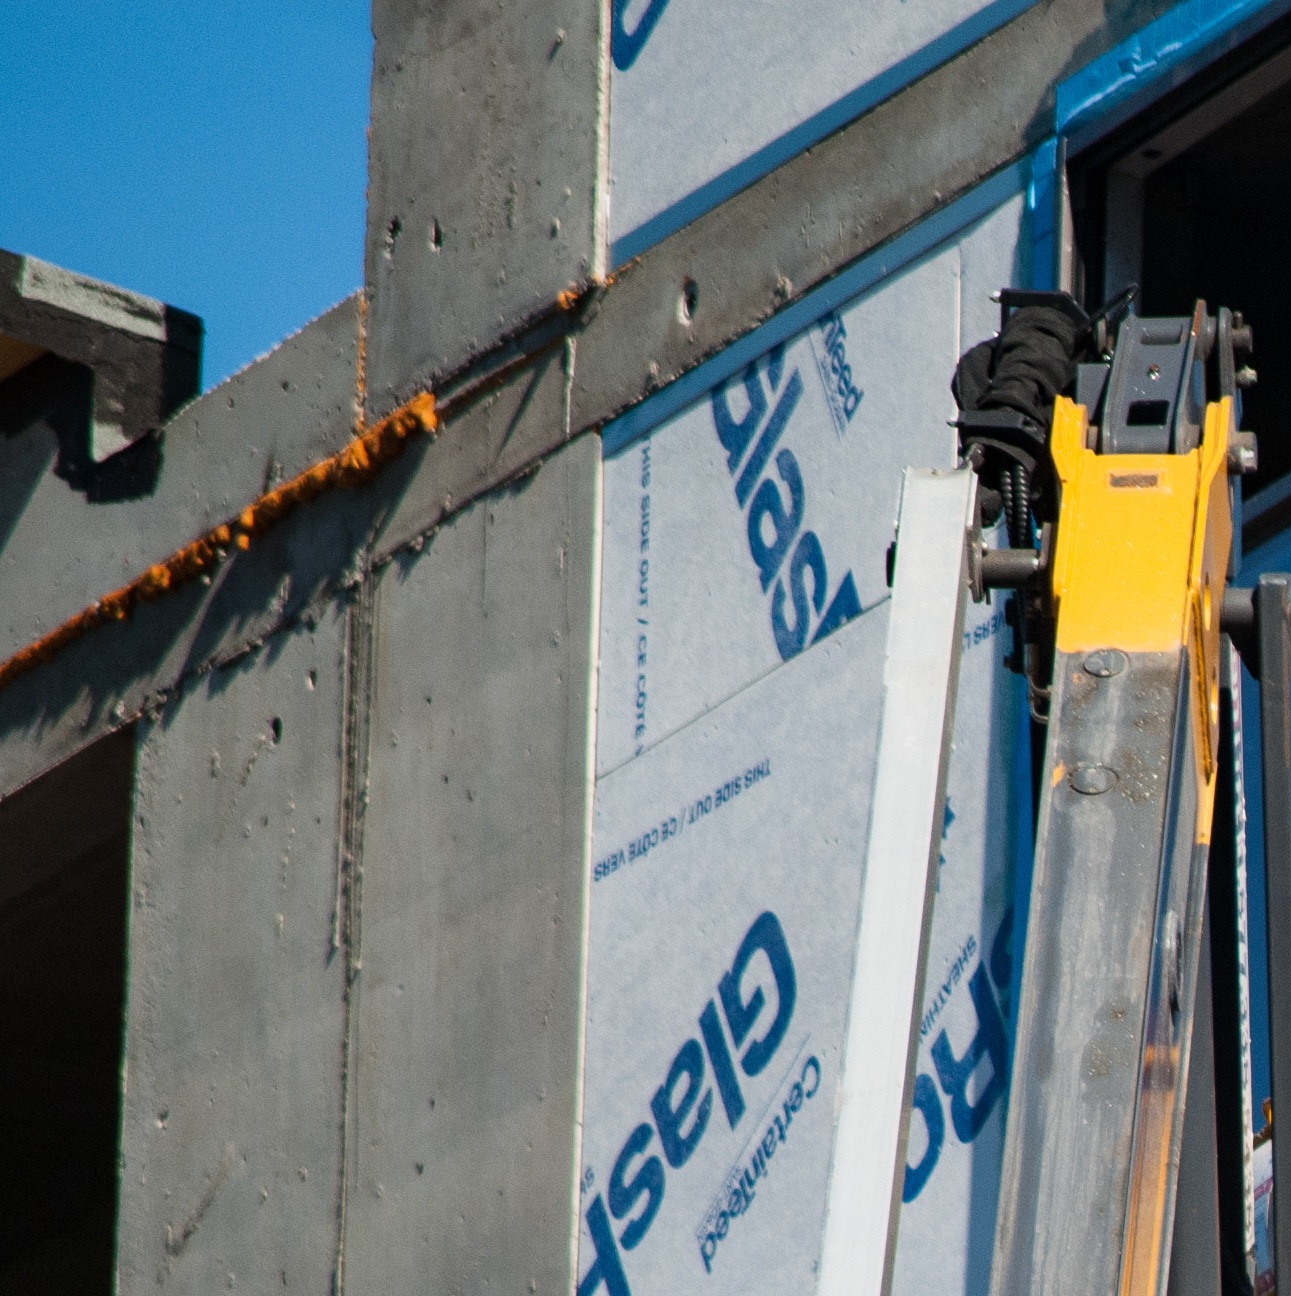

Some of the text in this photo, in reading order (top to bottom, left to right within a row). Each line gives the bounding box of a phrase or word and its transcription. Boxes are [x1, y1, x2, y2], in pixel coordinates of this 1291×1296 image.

[639, 495, 653, 554] SIDE
[637, 559, 650, 609] OUT
[635, 634, 649, 670] CE
[743, 758, 772, 790] THIS
[687, 795, 713, 826] OUT
[713, 775, 742, 810] SIDE
[660, 816, 678, 843] CE
[592, 848, 626, 884] VERS
[697, 1054, 822, 1275] CertainTeed
